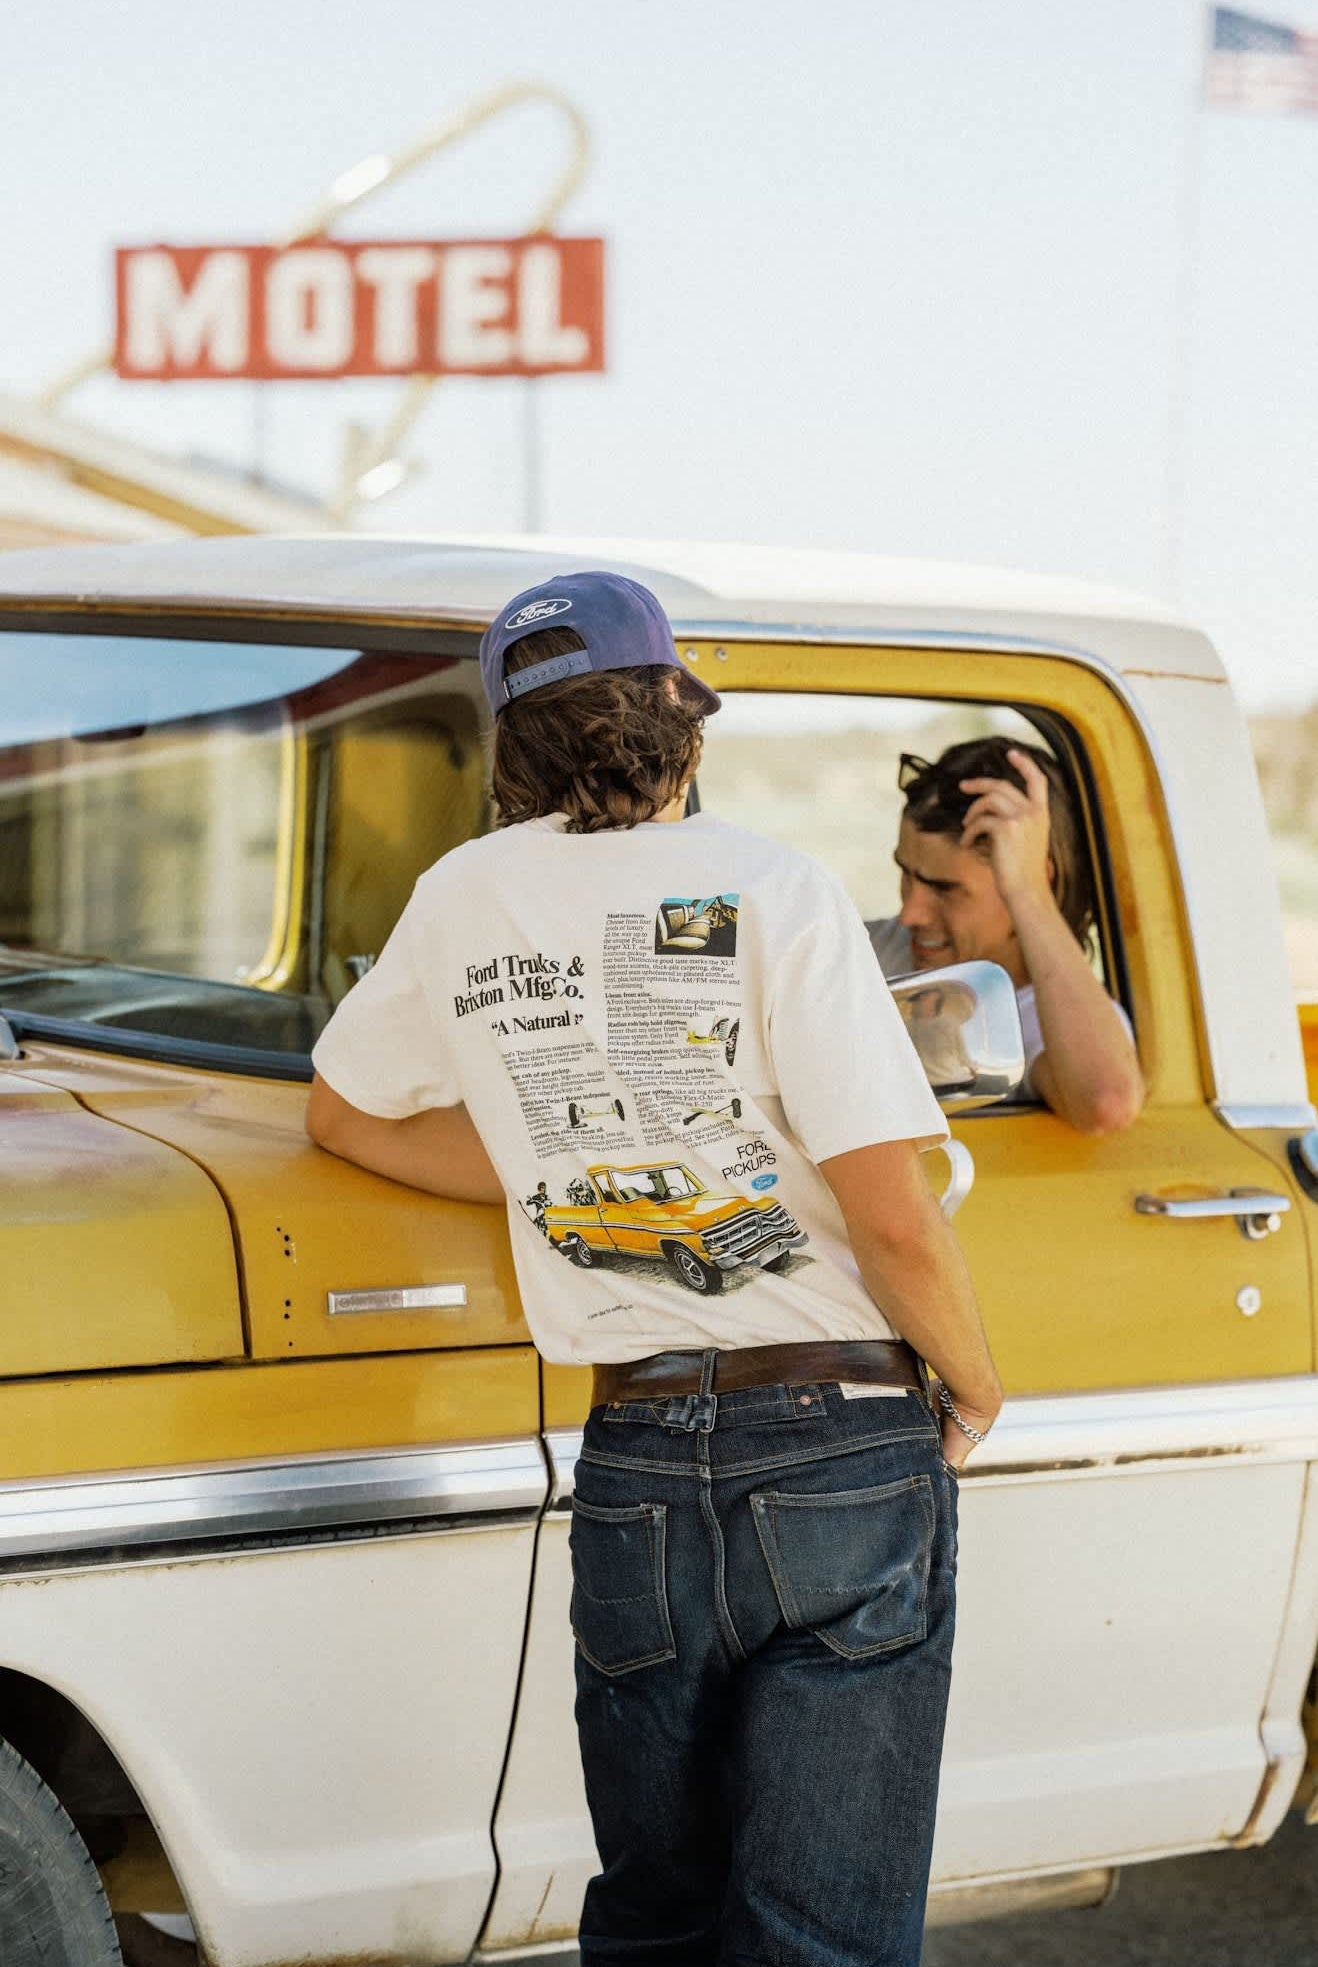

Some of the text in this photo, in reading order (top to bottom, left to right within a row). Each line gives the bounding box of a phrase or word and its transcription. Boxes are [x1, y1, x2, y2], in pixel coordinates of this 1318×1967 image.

[124, 243, 590, 371] MOTEL
[517, 601, 558, 623] Ford
[466, 953, 584, 988] Ford Truks &
[454, 987, 504, 1018] Brixton
[512, 1010, 570, 1034] Natural
[722, 1153, 776, 1180] PICKUPS
